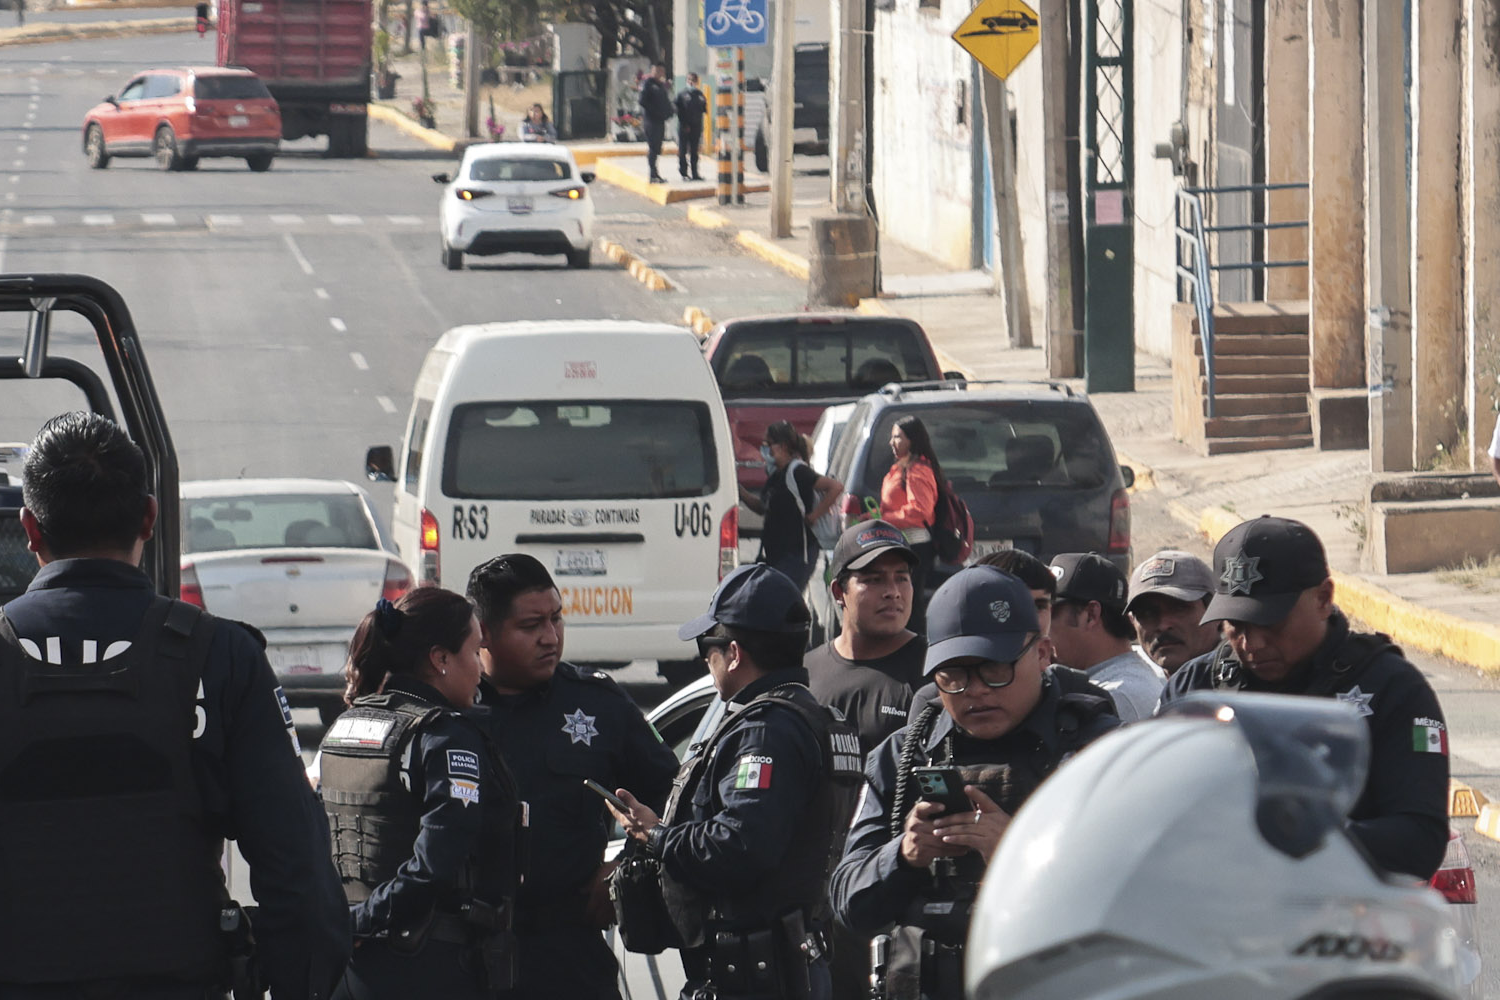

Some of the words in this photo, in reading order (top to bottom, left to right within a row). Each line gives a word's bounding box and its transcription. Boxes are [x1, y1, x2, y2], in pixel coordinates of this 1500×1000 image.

[530, 509, 566, 524] PARADAS
[595, 508, 640, 524] CONTINUAS
[561, 586, 633, 616] CAUCION
[881, 705, 907, 717] Wilson
